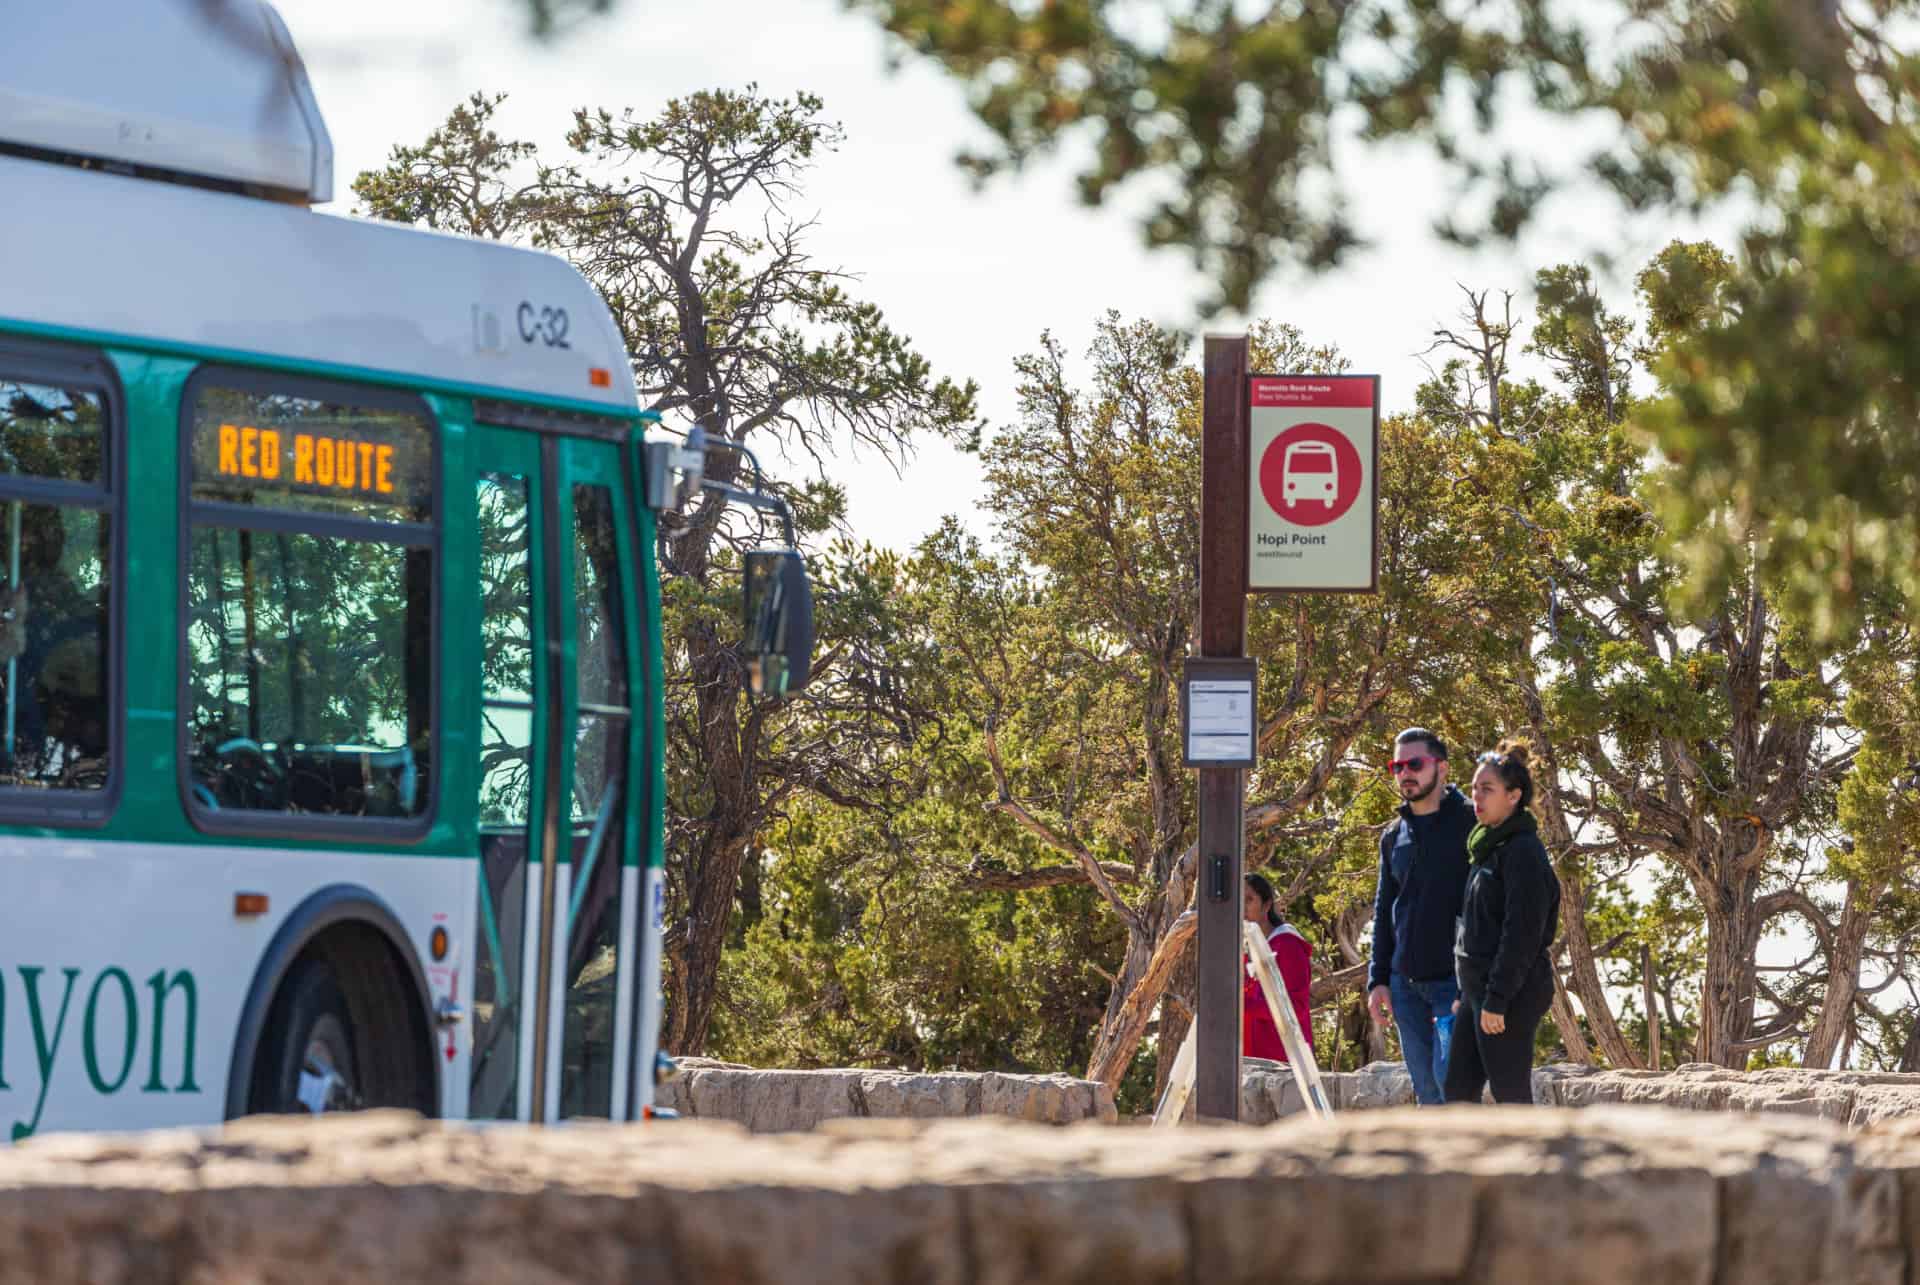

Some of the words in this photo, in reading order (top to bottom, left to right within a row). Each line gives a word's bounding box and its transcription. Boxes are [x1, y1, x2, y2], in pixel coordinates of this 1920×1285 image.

[517, 301, 571, 350] C-32
[219, 424, 281, 480] RED
[295, 434, 393, 494] ROUTE
[1257, 533, 1288, 548] Hopi
[1292, 533, 1326, 545] Point
[0, 965, 202, 1142] yon
